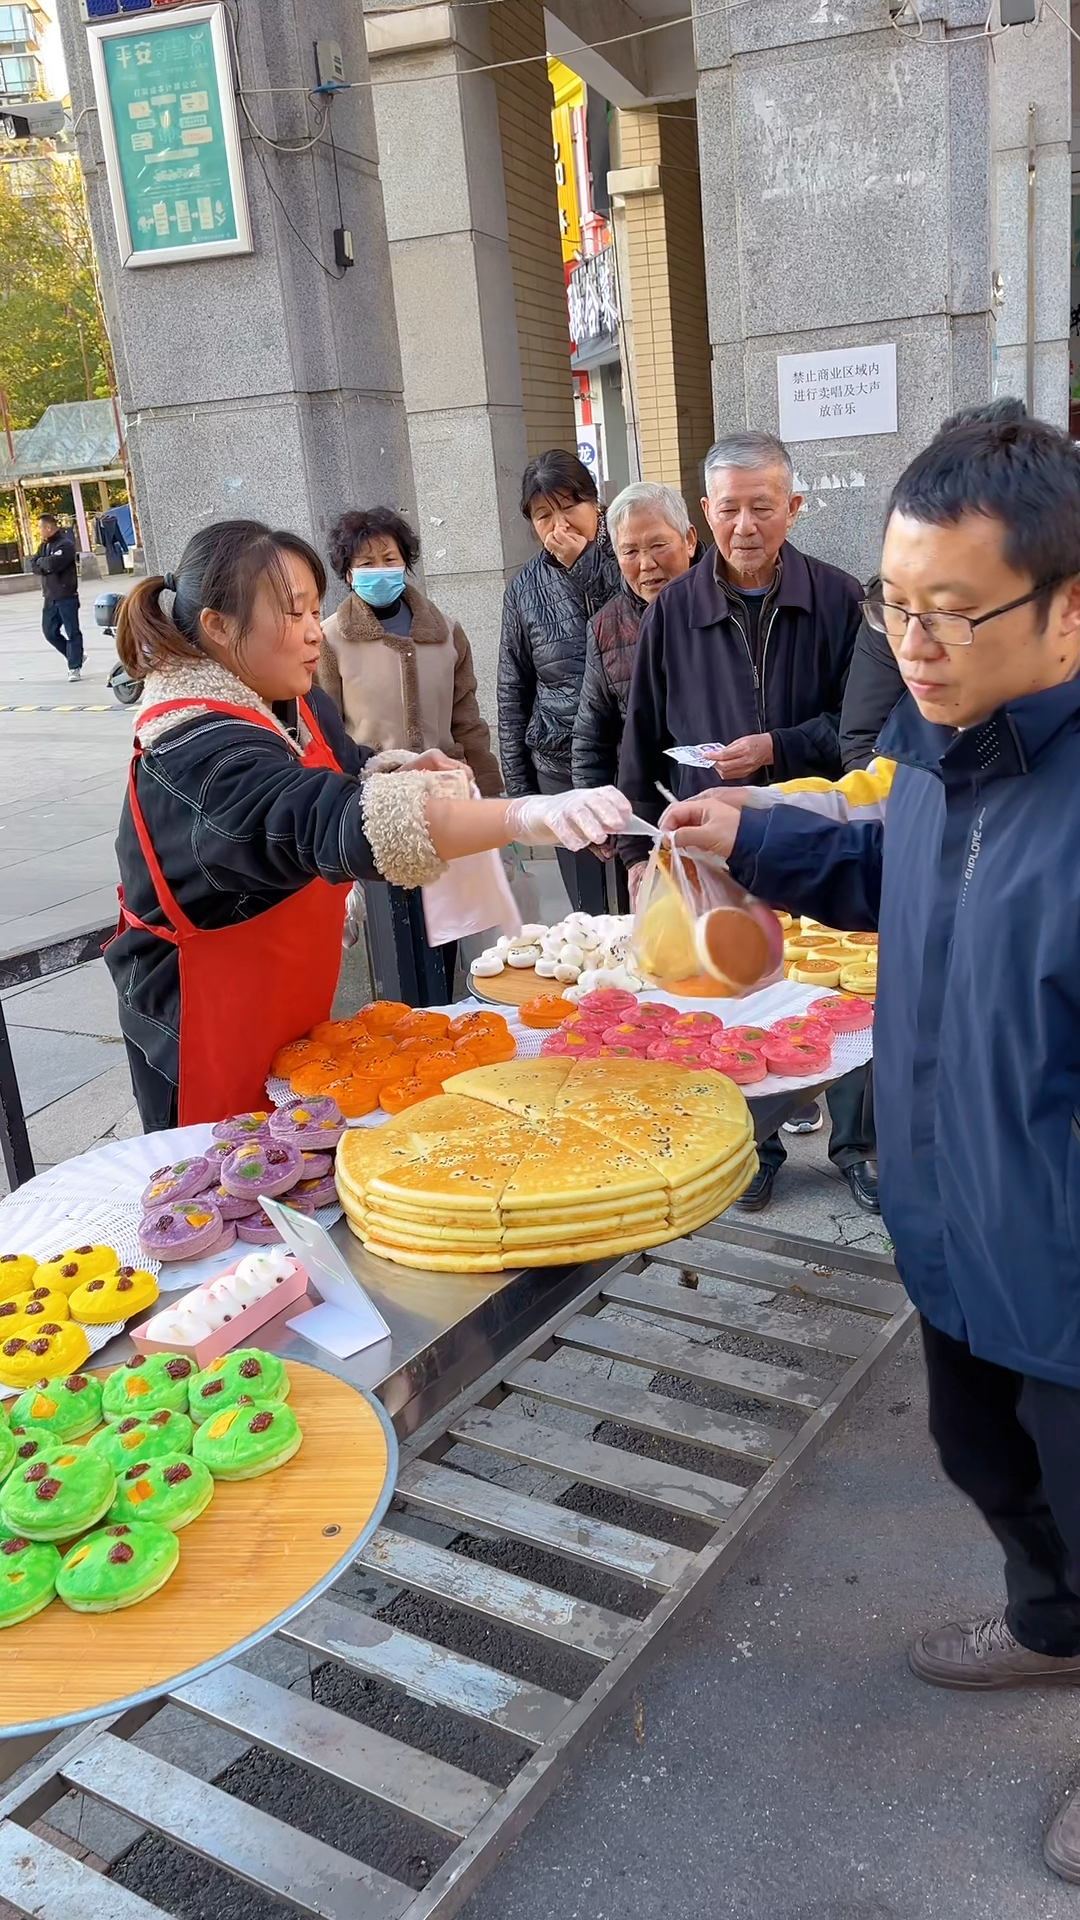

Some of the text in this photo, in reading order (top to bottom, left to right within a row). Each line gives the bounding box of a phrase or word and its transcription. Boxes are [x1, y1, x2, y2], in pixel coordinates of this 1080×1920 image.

[792, 362, 880, 384] 禁止商业区域内
[793, 381, 881, 403] 进行卖唱及大声
[819, 401, 857, 418] 放音乐
[577, 445, 593, 463] 龙
